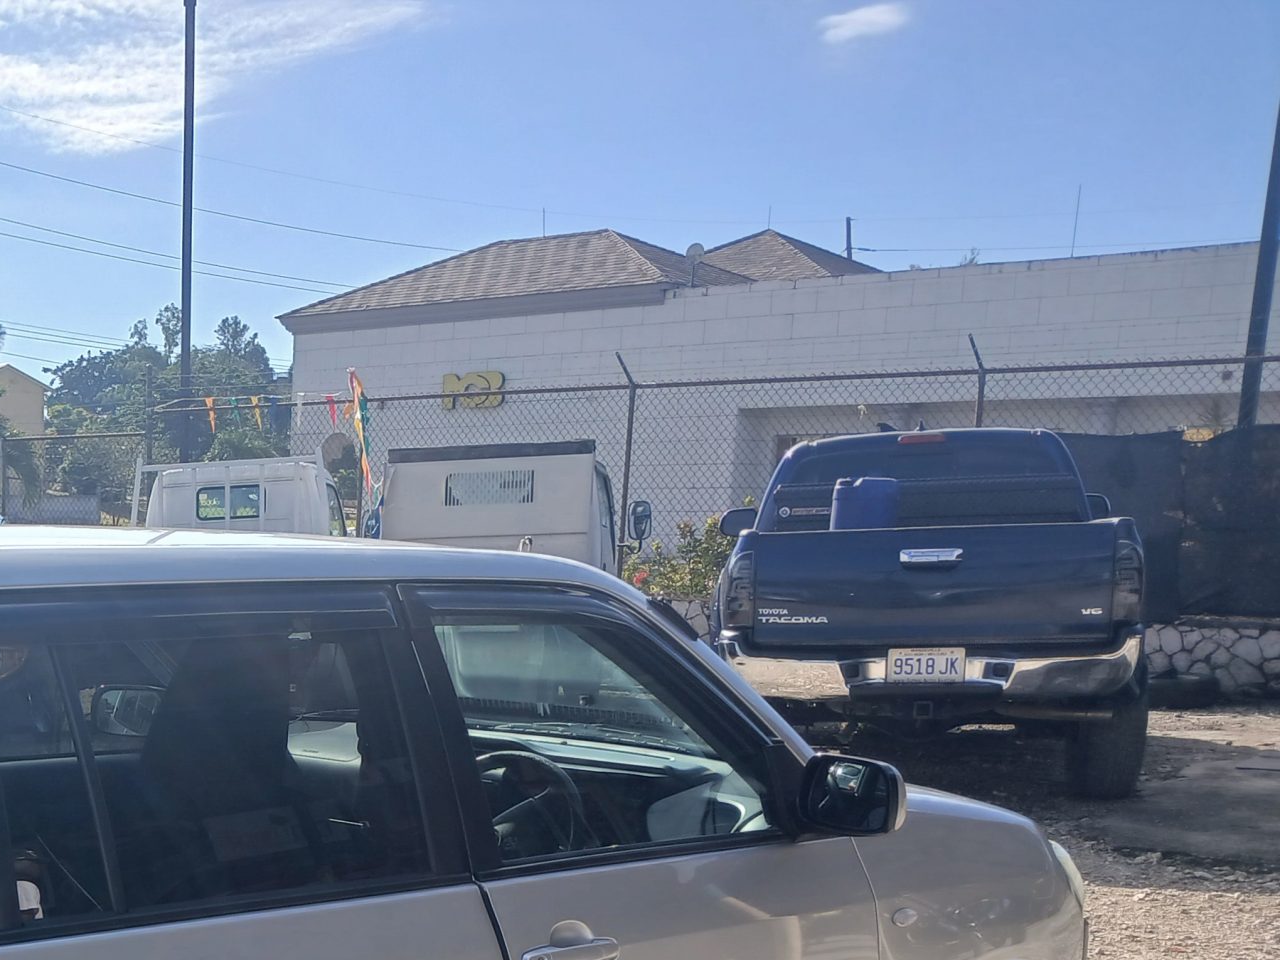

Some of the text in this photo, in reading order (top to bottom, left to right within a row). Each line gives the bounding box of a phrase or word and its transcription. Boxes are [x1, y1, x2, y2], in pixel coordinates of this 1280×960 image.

[1080, 607, 1103, 615] V6
[757, 616, 829, 624] TACOMA
[893, 657, 959, 676] 9518 JK
